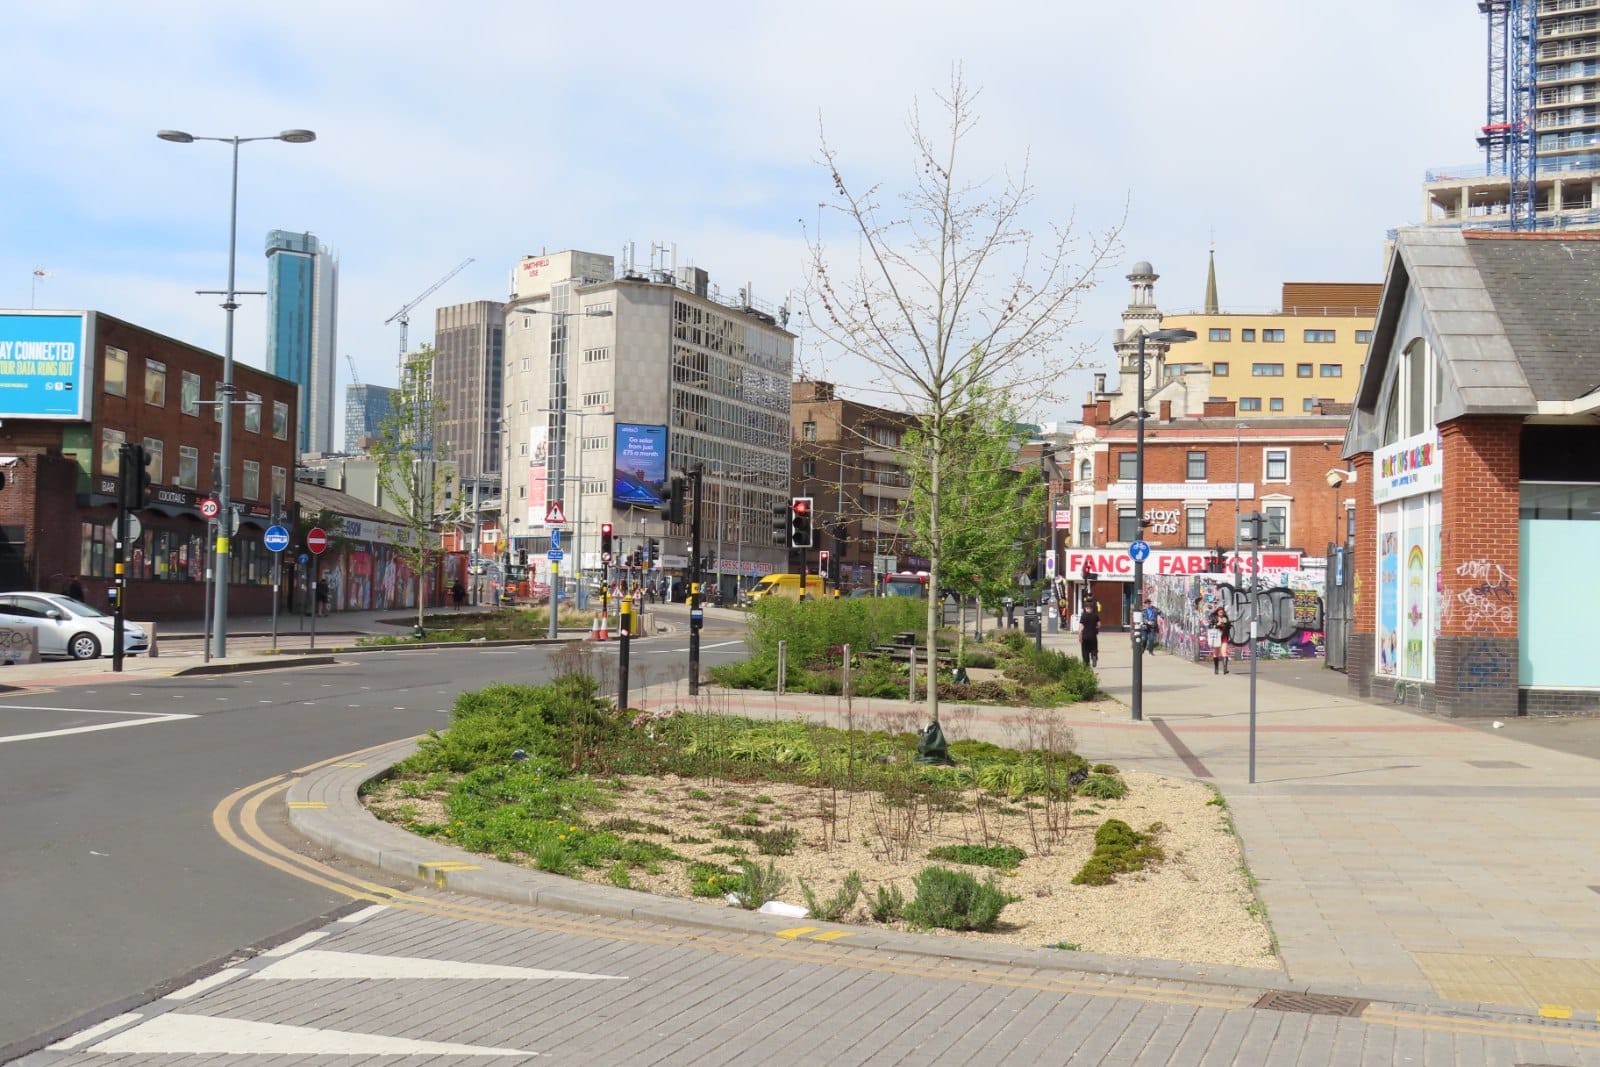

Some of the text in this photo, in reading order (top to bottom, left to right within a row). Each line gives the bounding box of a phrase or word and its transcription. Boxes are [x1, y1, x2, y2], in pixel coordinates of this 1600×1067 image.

[15, 341, 75, 361] CONNECTED
[102, 481, 115, 492] BAR
[158, 490, 186, 504] COCKTAILS
[203, 504, 216, 513] 20
[1144, 508, 1174, 523] stay
[1151, 520, 1177, 534] inns
[1070, 554, 1132, 573] FANC
